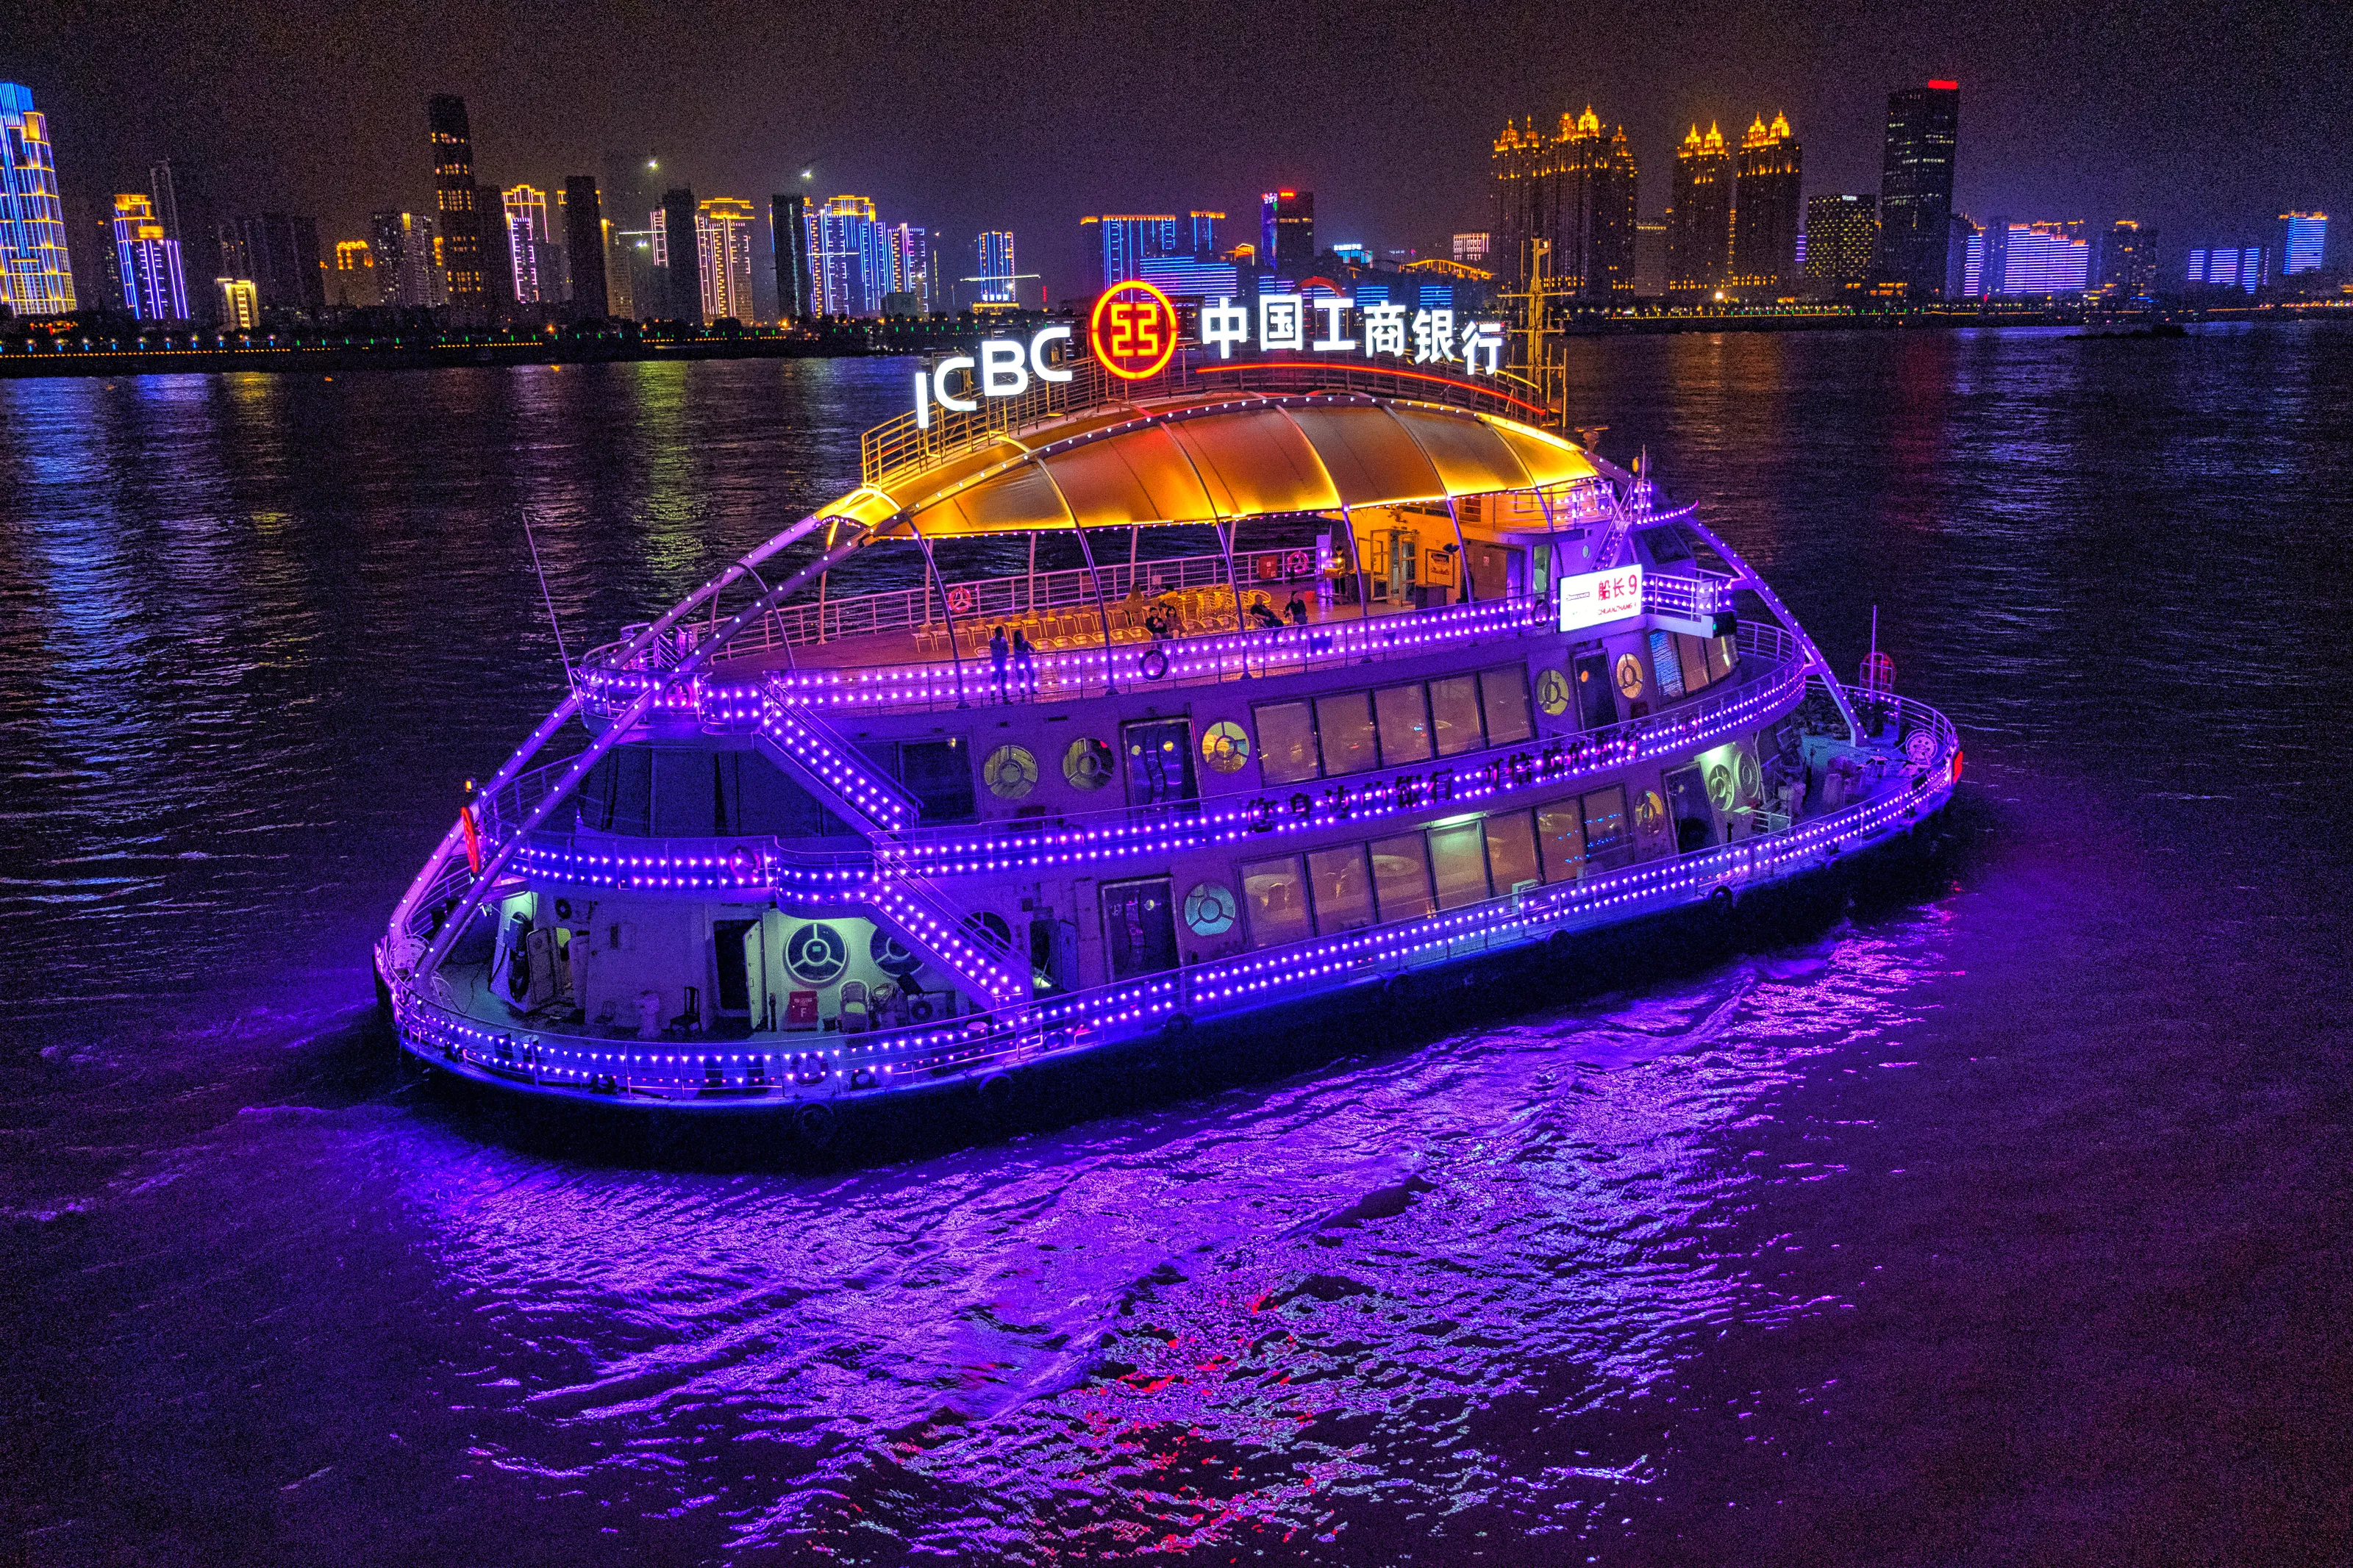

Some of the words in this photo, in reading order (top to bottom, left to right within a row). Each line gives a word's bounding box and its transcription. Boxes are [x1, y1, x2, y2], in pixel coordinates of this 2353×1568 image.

[915, 326, 1074, 430] ICBC
[1202, 294, 1503, 376] 中国工商银行
